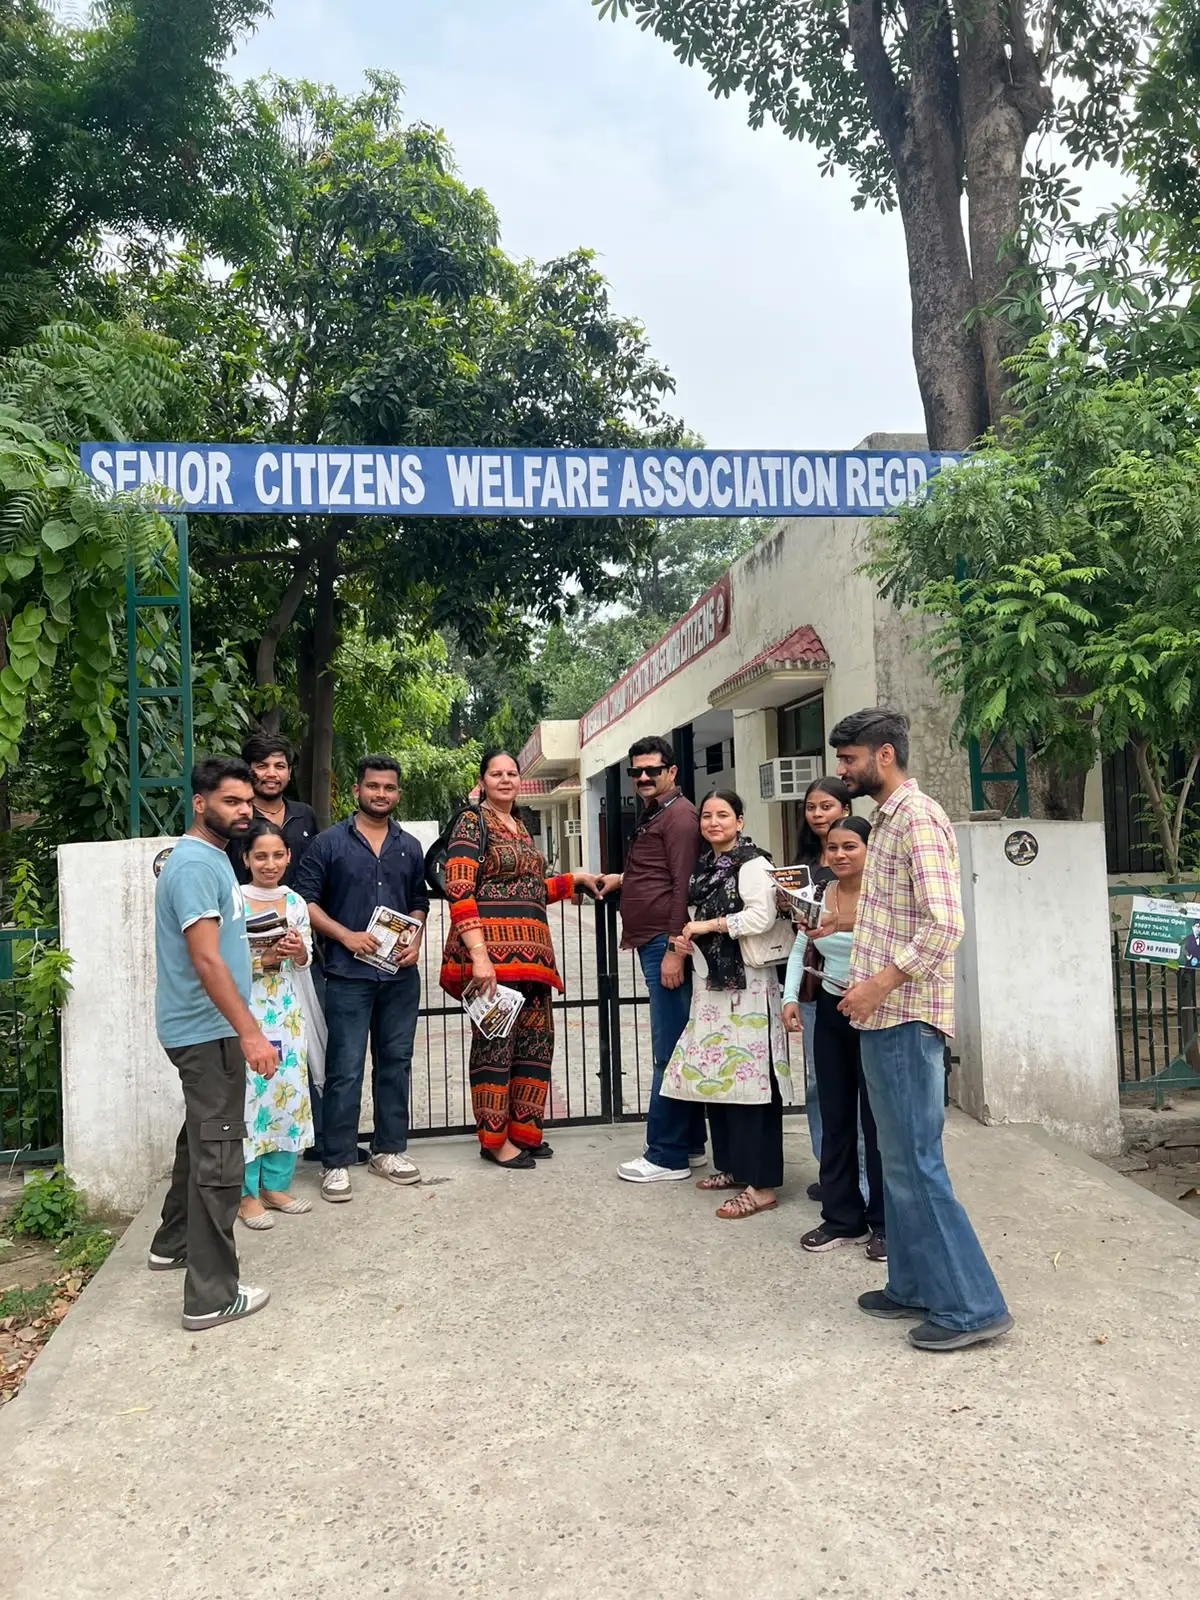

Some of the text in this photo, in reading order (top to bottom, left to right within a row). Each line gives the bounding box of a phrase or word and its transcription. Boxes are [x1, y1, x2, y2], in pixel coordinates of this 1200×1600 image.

[91, 450, 928, 508] SENIOR CITIZENS WELFARE ASSOCIATION REGD
[1135, 914, 1170, 924] Admissions
[1155, 946, 1178, 954] PARKING
